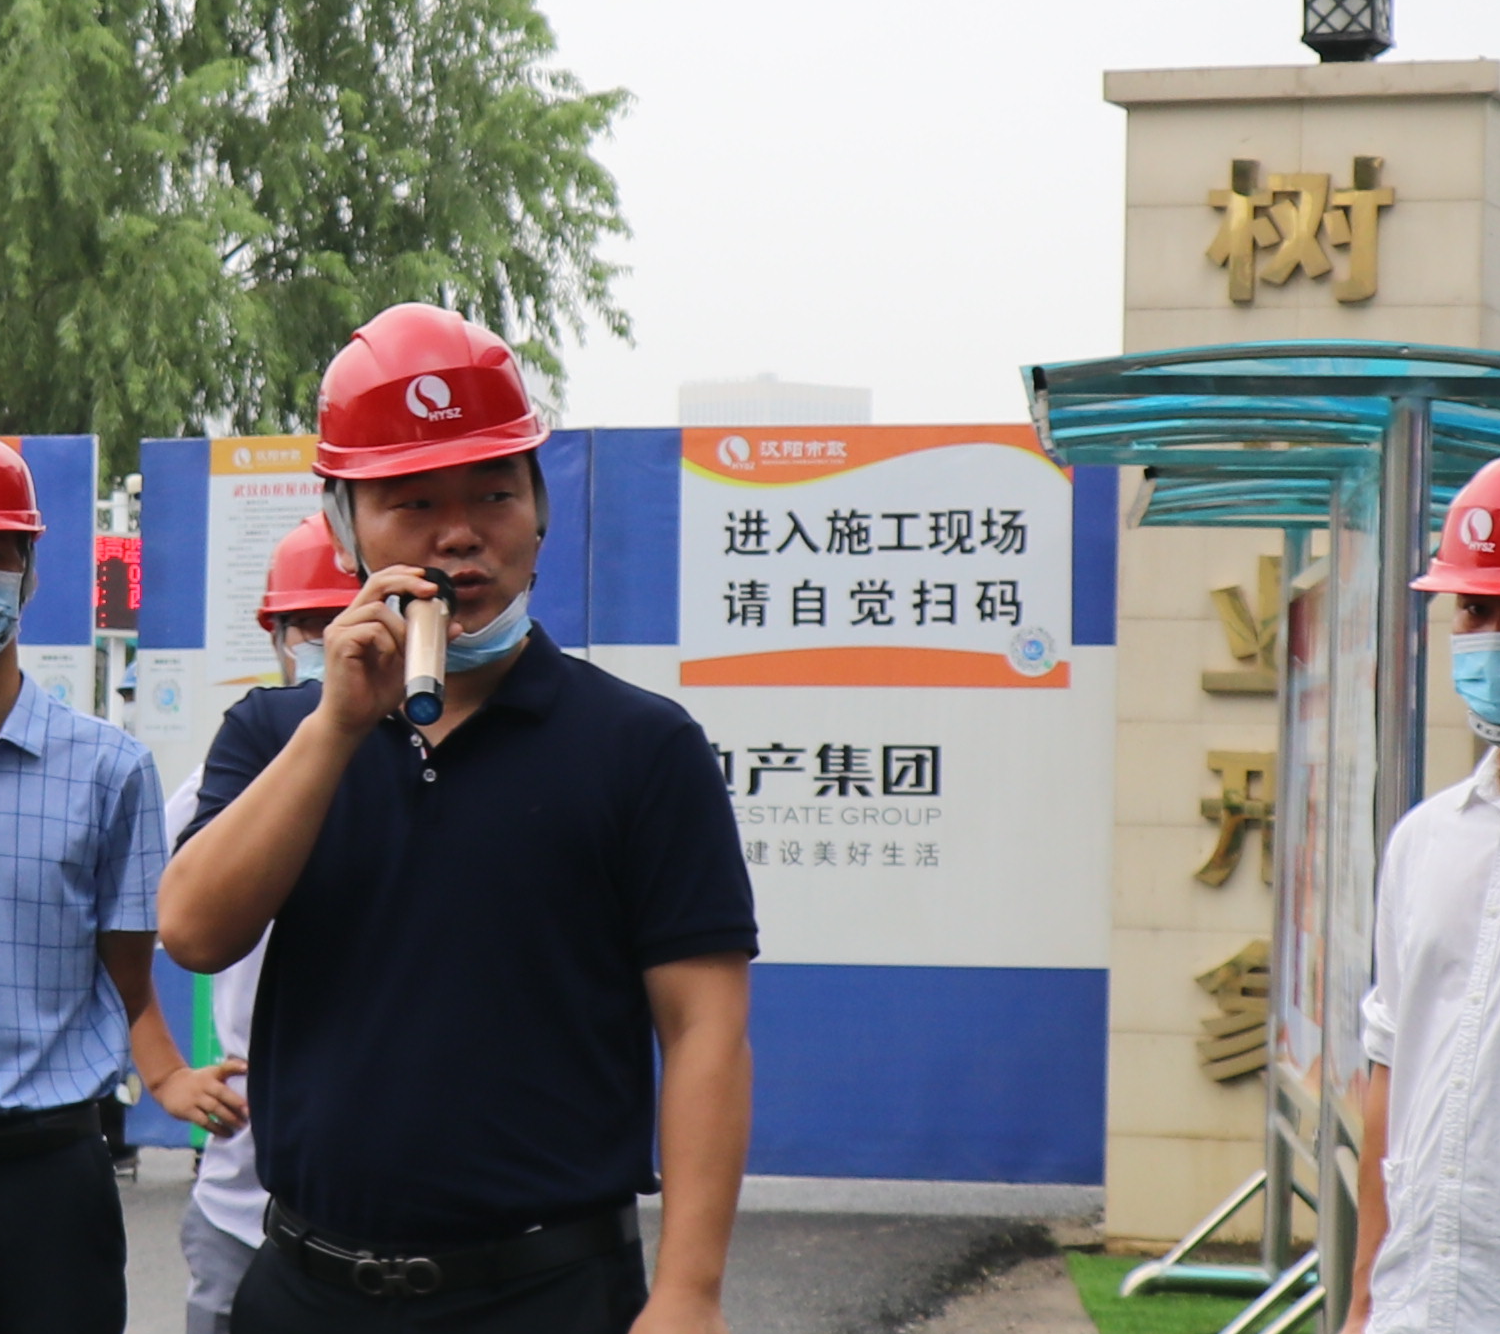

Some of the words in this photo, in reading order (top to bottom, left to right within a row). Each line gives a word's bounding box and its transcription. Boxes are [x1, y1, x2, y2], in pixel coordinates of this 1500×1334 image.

[428, 407, 463, 422] HYSZ
[760, 439, 848, 458] 汉阳市政
[724, 508, 1028, 555] 进入施工现场
[1469, 541, 1497, 553] HYSZ
[723, 579, 1024, 627] 请自觉扫码
[841, 806, 942, 826] GROUP
[745, 840, 941, 867] 建设美好生活
